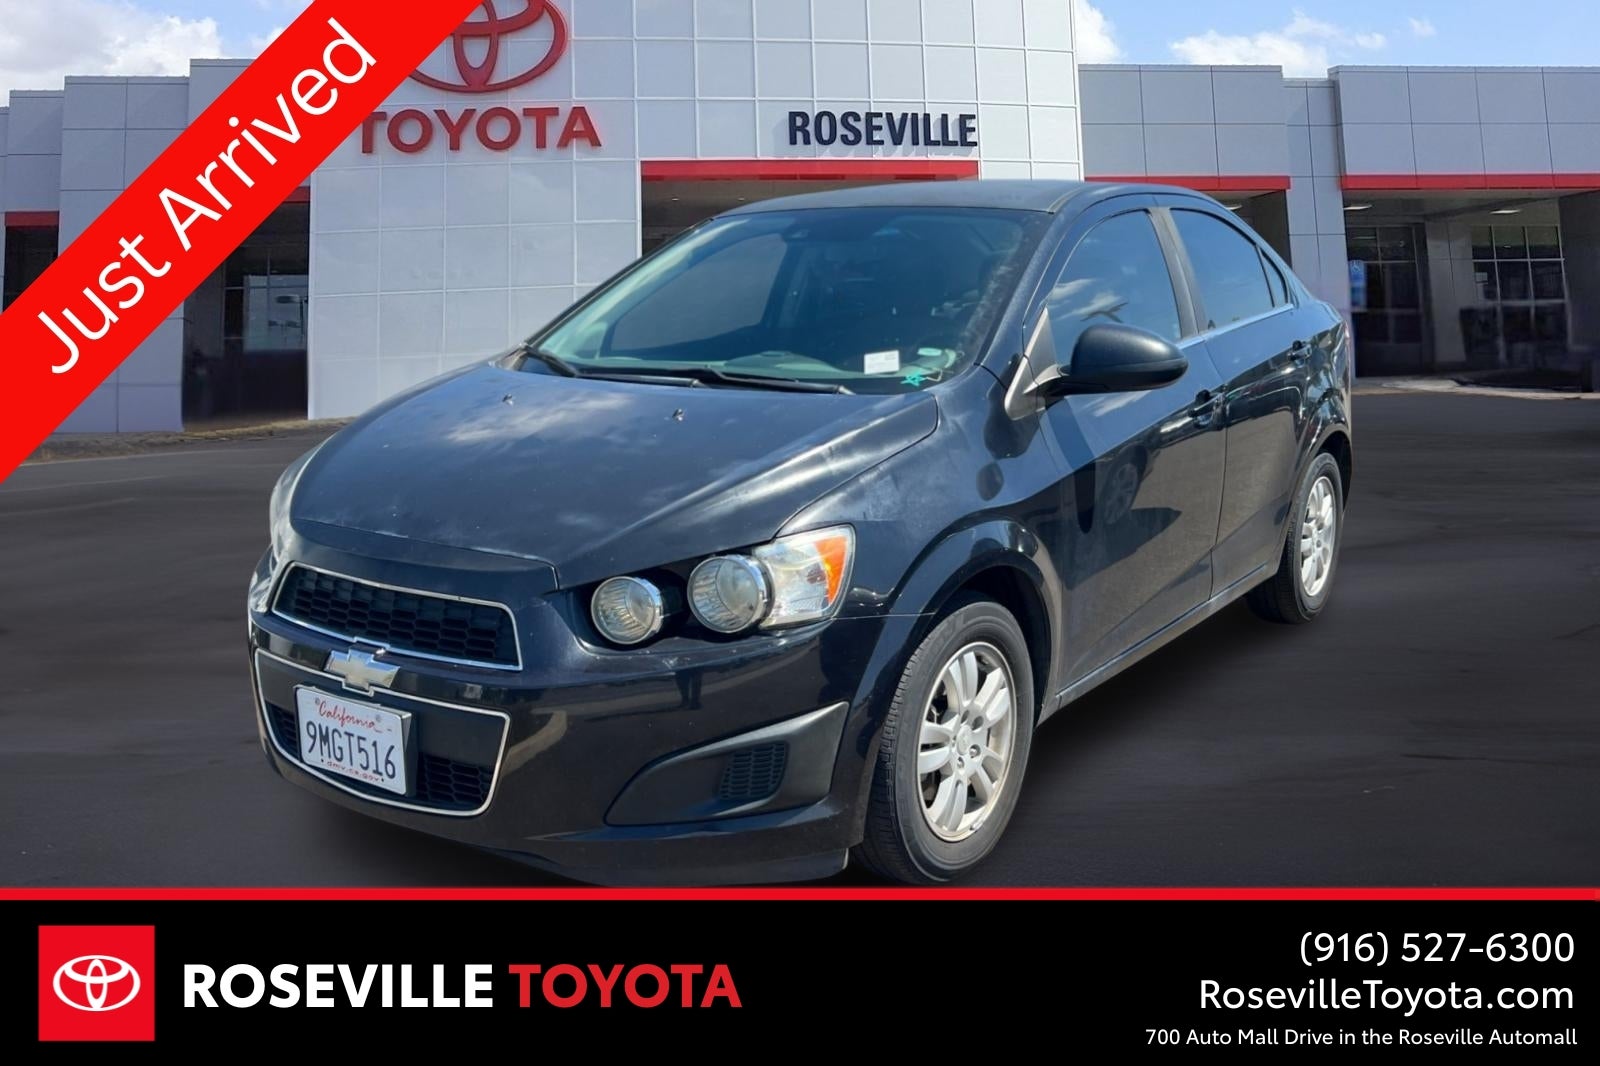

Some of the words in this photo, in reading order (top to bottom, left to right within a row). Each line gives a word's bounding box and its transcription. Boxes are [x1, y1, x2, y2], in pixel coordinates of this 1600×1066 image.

[362, 106, 602, 154] TOYOTA
[788, 110, 978, 147] ROSEVILLE
[319, 700, 383, 733] California
[306, 720, 395, 779] 9MGT516
